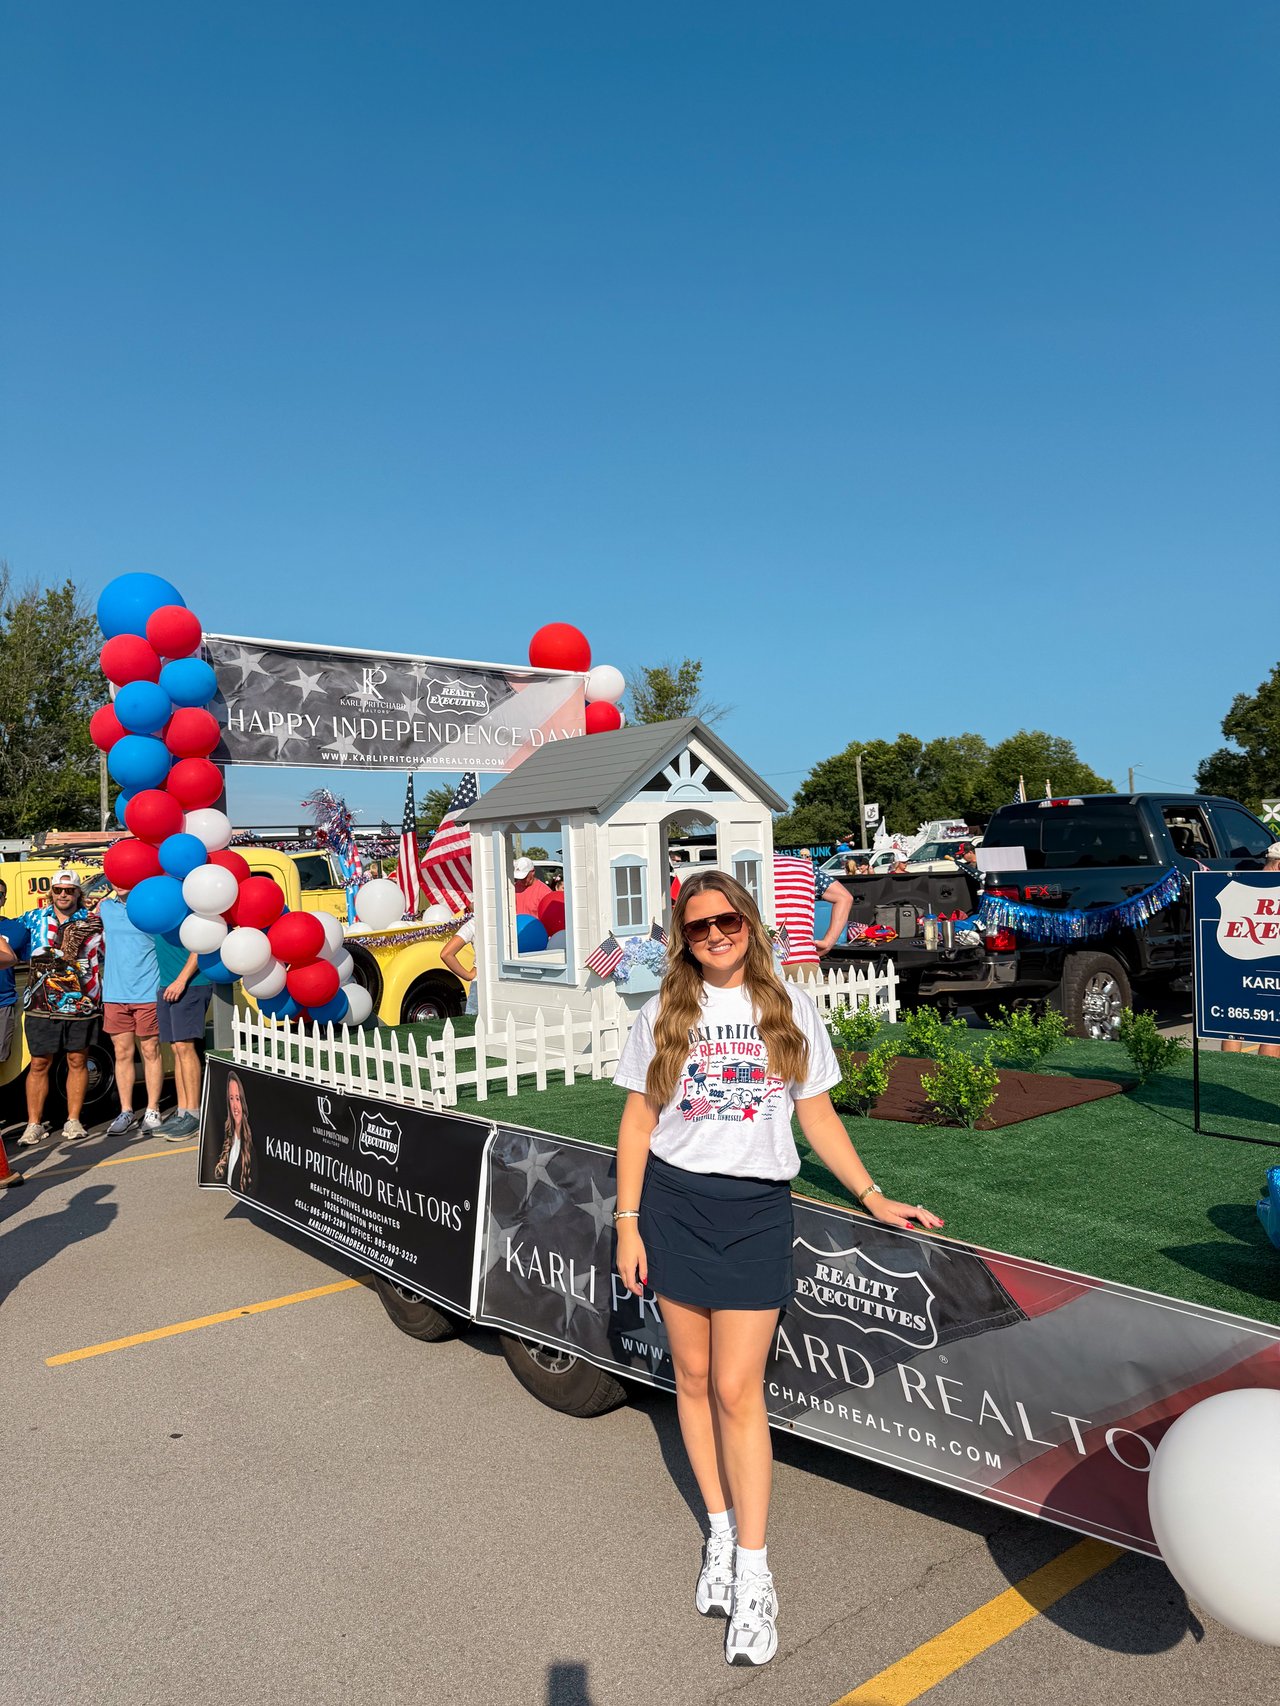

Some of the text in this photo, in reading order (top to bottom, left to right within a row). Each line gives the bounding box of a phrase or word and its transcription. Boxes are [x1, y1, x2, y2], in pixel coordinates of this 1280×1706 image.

[340, 698, 406, 710] KARLI PRITCHARD
[429, 694, 487, 708] EXECUTIVES
[441, 687, 476, 698] REALTY
[227, 707, 321, 737] HAPPY
[332, 716, 523, 747] INDEPENDENCE
[321, 751, 505, 766] WWW.KARLIPRITCHARDREALTOR.COM
[1024, 883, 1062, 900] FX4
[1254, 898, 1280, 916] R
[1224, 916, 1280, 945] EXE
[1210, 1005, 1280, 1022] C: 865.591.
[716, 1023, 763, 1041] PRITC
[699, 1041, 762, 1057] REALTORS
[361, 1130, 398, 1154] EXECUTIVES
[366, 1122, 392, 1139] REALTY
[266, 1135, 302, 1167] KARLI
[305, 1148, 373, 1198] PRITCHARD
[309, 1182, 401, 1230] REALTY EXECUTIVES ASSOCIATES
[323, 1200, 384, 1236] 10255 KINGSTON PIKE
[294, 1198, 310, 1212] CELL:
[350, 1225, 373, 1243] OFFICE:
[307, 1217, 395, 1268] KARLIPRITCHARDREALTOR.COM
[505, 1236, 597, 1304] KARLI
[815, 1263, 899, 1303] REALTY
[795, 1276, 927, 1332] EXECUTIVES
